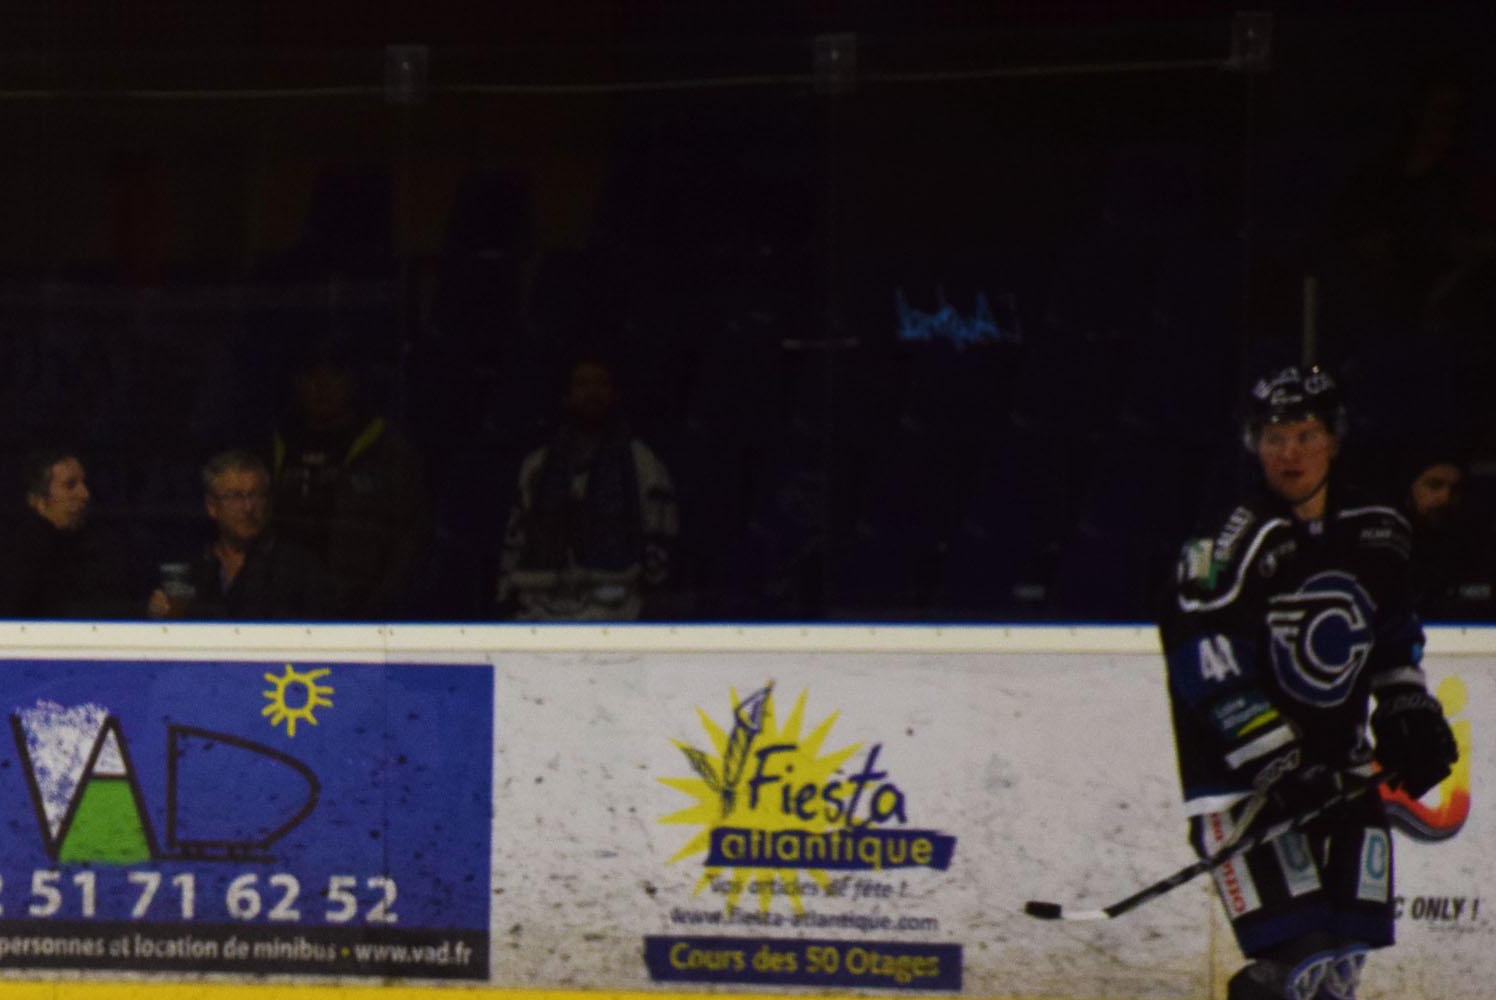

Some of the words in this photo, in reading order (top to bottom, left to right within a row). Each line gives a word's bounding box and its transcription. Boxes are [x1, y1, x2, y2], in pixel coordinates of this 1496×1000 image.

[749, 743, 908, 828] Fiesta
[719, 831, 936, 872] atlantique
[28, 868, 99, 918] 51
[126, 871, 197, 920] 71
[224, 873, 303, 922] 62
[324, 875, 400, 923] 52
[1411, 896, 1467, 921] ONLY
[134, 932, 219, 958] location
[223, 935, 250, 958] de
[254, 937, 338, 961] minibus
[356, 940, 474, 966] www.vad.fr
[669, 942, 745, 972] Cours
[751, 944, 798, 973] des
[845, 947, 940, 984] Otages
